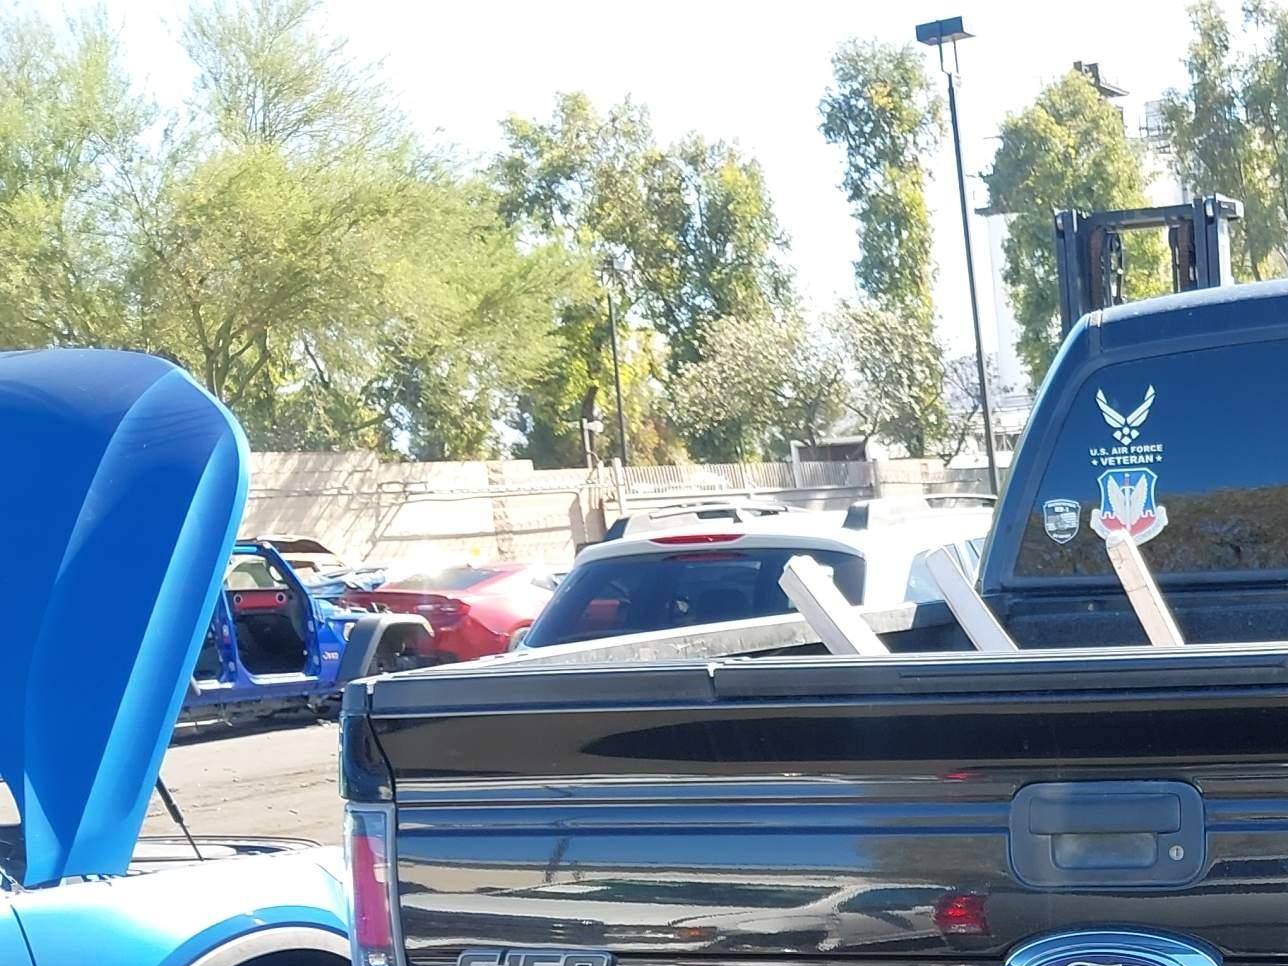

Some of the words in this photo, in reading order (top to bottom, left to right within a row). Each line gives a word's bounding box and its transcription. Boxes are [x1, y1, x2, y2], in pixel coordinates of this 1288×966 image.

[1089, 448, 1109, 456] U.S.
[1111, 446, 1128, 455] AIR
[1130, 444, 1163, 453] FORCE
[1100, 455, 1154, 466] VETERAN
